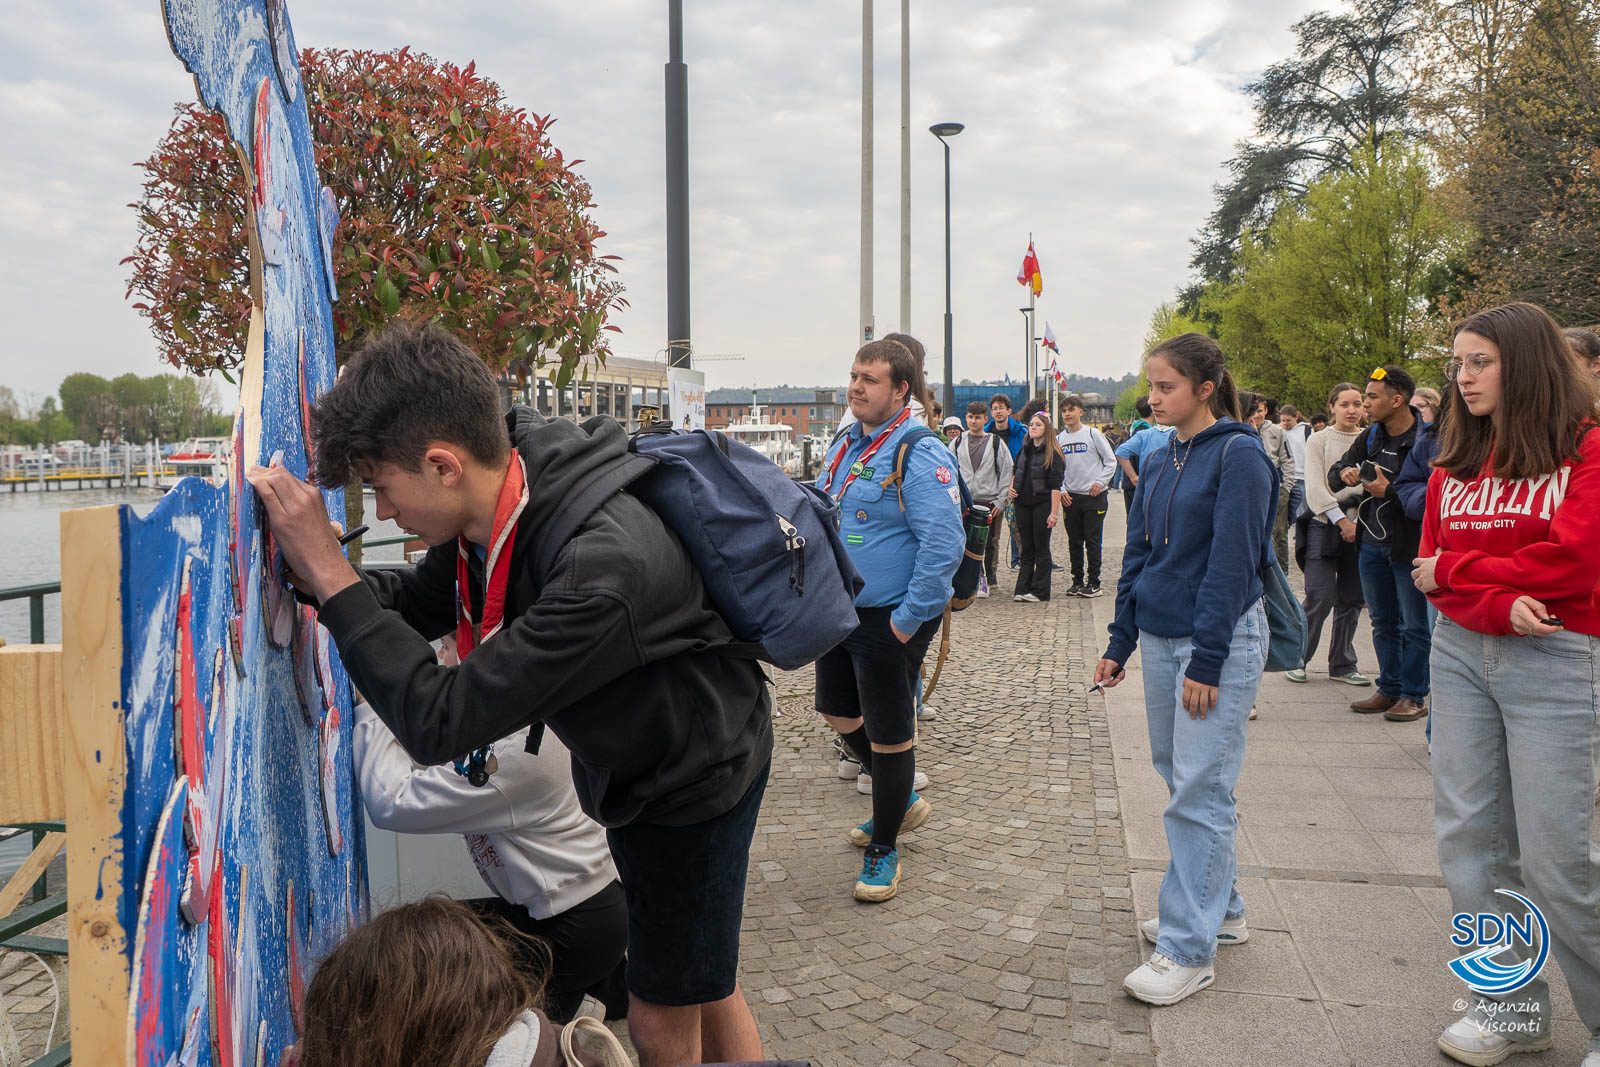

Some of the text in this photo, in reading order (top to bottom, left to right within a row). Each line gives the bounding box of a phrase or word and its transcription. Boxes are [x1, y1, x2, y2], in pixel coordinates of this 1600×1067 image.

[1441, 466, 1572, 521] ROOKLYN
[1450, 519, 1516, 530] NEW YORK CITY
